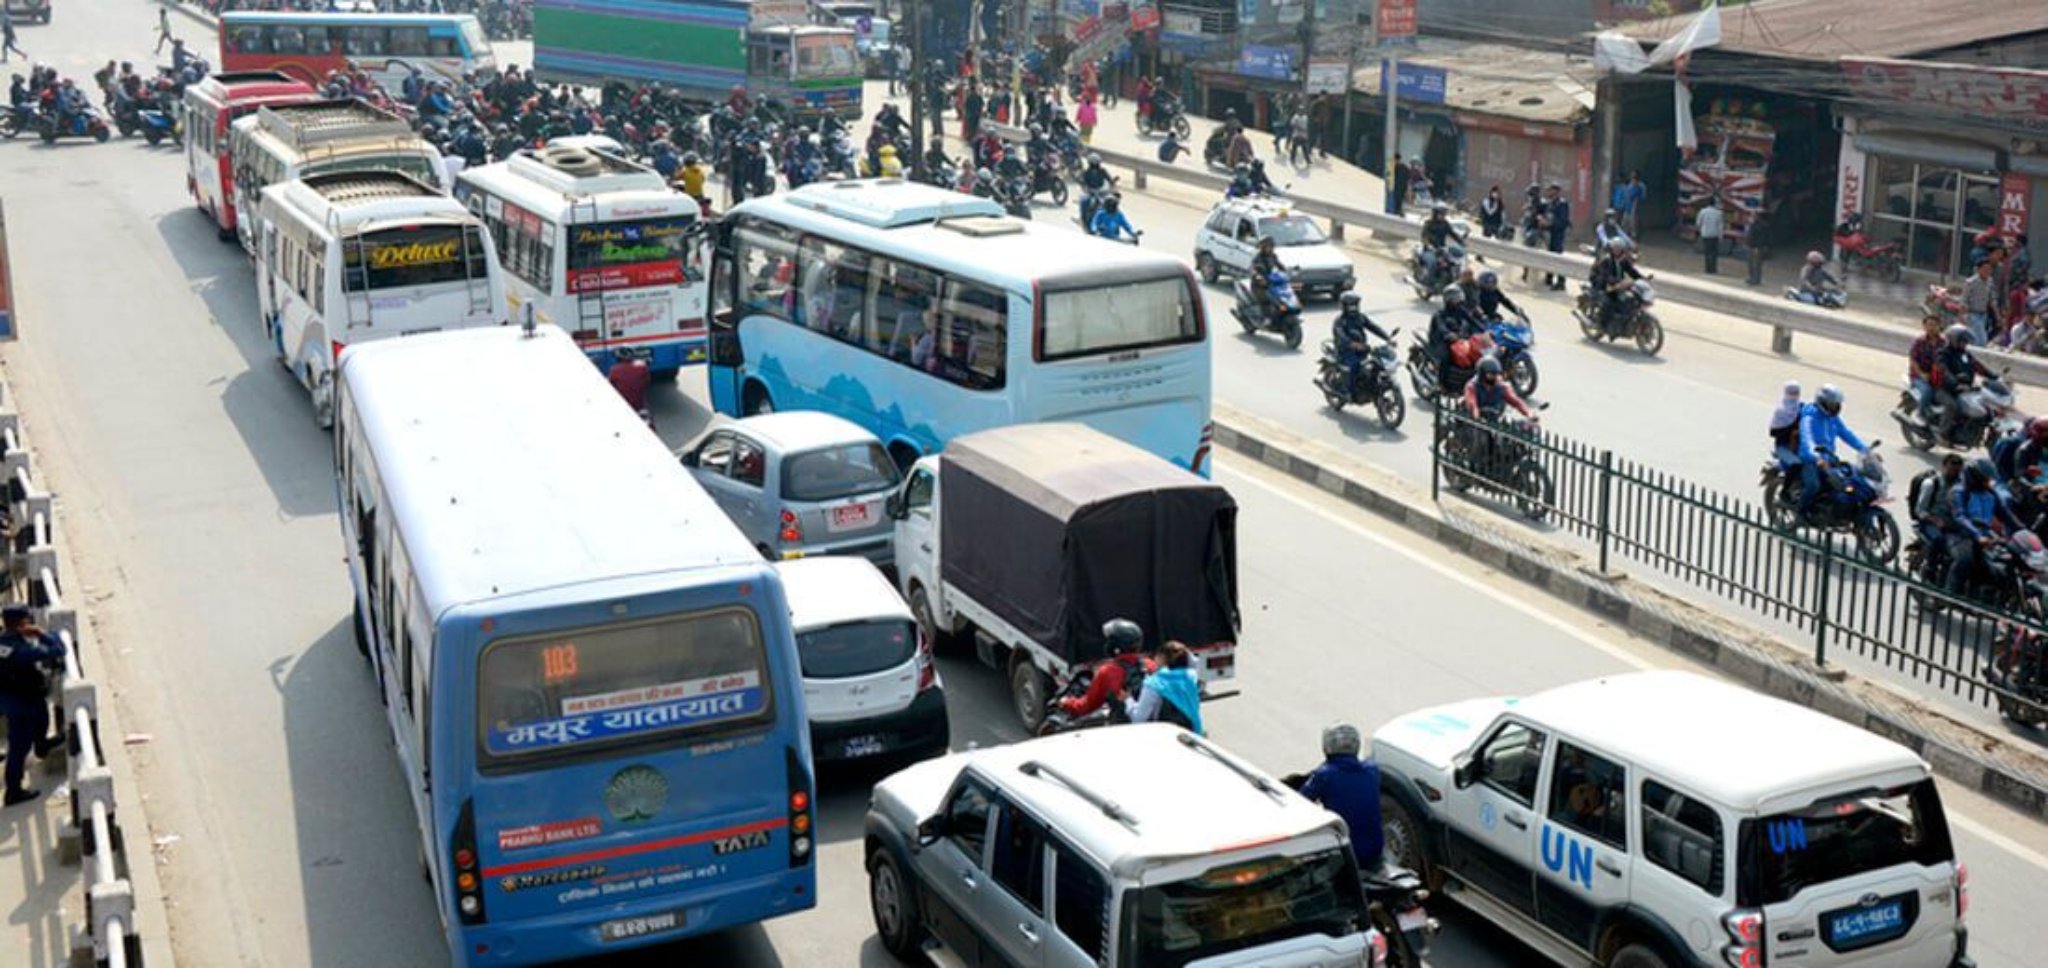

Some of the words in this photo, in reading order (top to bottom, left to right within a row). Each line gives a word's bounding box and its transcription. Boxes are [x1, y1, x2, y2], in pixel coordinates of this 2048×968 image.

[372, 240, 459, 268] Deluxe
[506, 715, 594, 743] मयूर
[603, 692, 745, 729] यातायात
[500, 831, 544, 848] PRABHU
[715, 831, 769, 854] TATA
[1767, 818, 1807, 854] UN
[1541, 823, 1593, 891] UN
